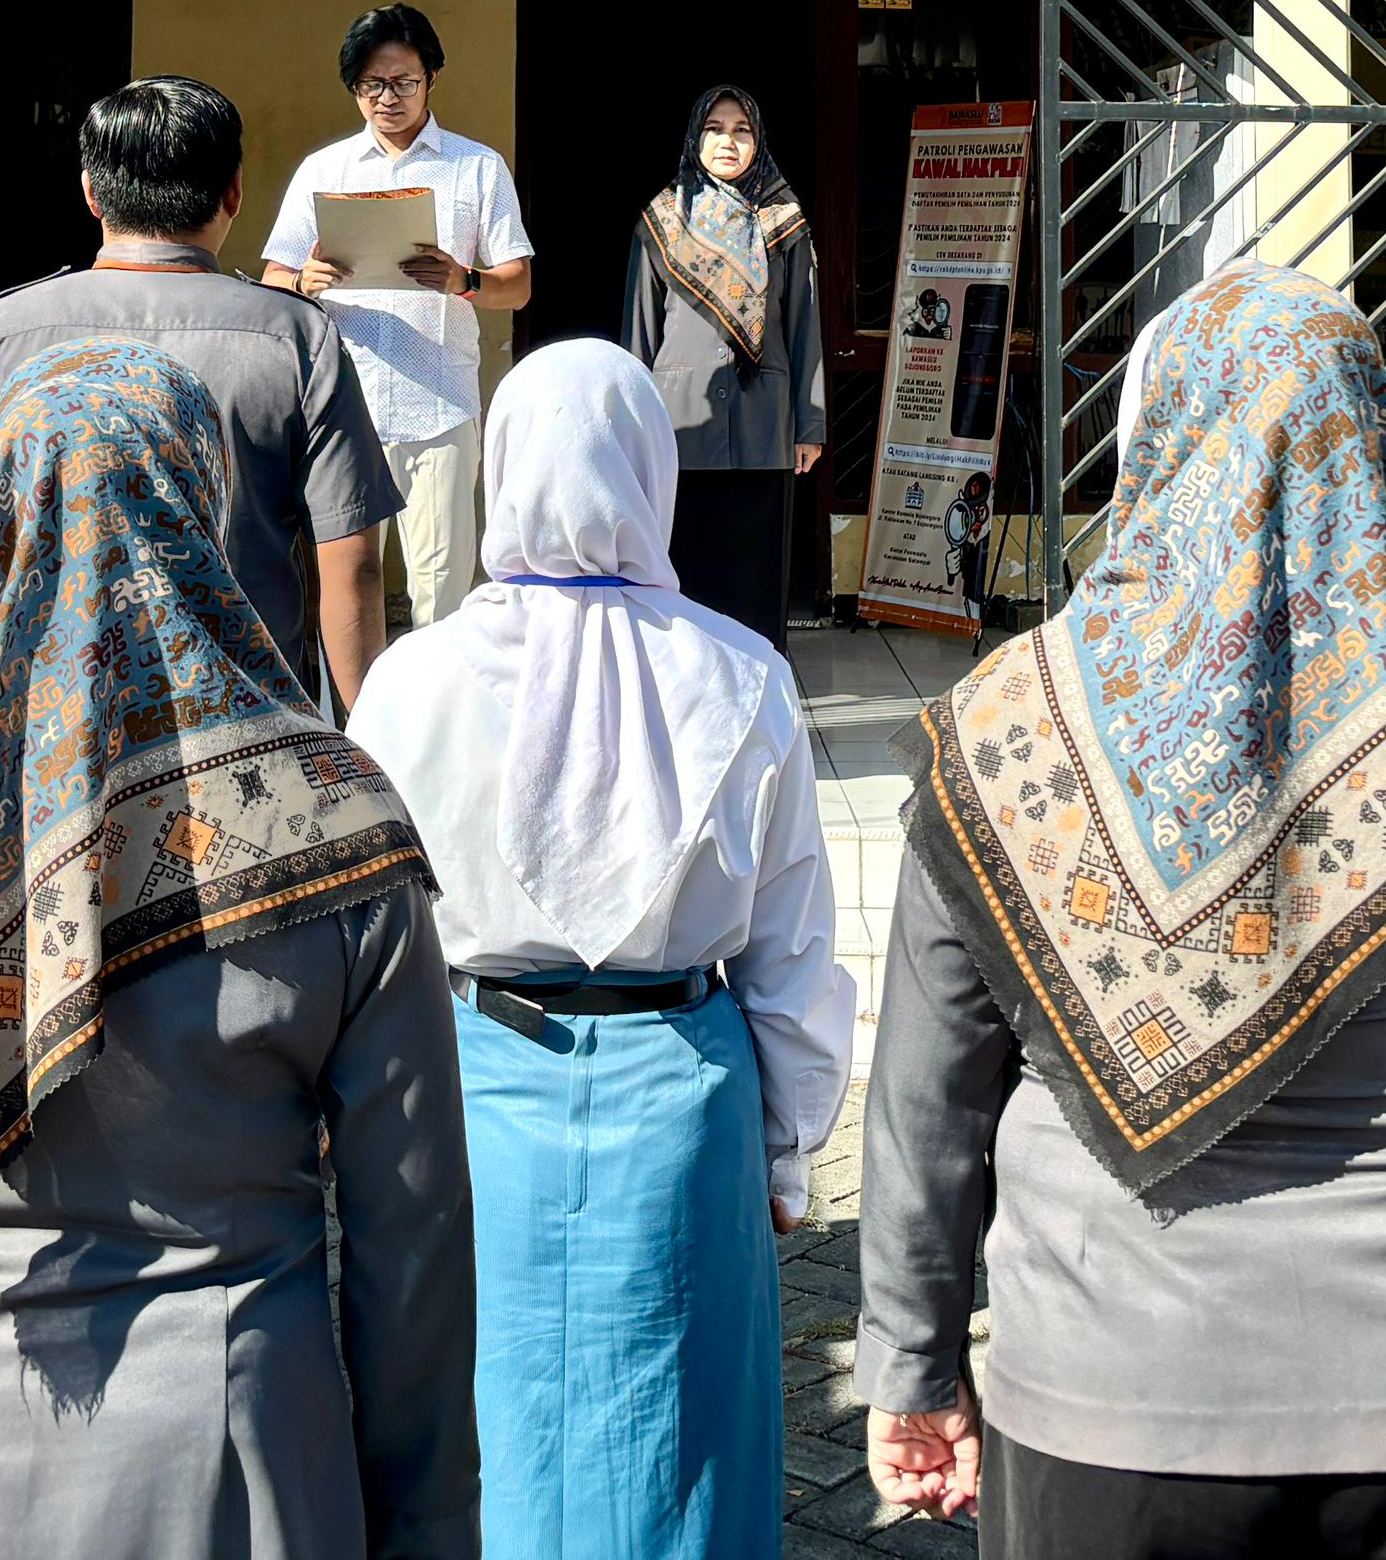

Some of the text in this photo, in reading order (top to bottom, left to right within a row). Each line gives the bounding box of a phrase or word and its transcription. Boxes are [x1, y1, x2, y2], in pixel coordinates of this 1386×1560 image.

[918, 143, 1024, 157] PATROLI PENGAWASAN
[913, 158, 961, 179] KAWAL
[961, 158, 990, 178] HAK
[941, 224, 957, 232] ANDA
[959, 224, 991, 232] TERDAFTAR
